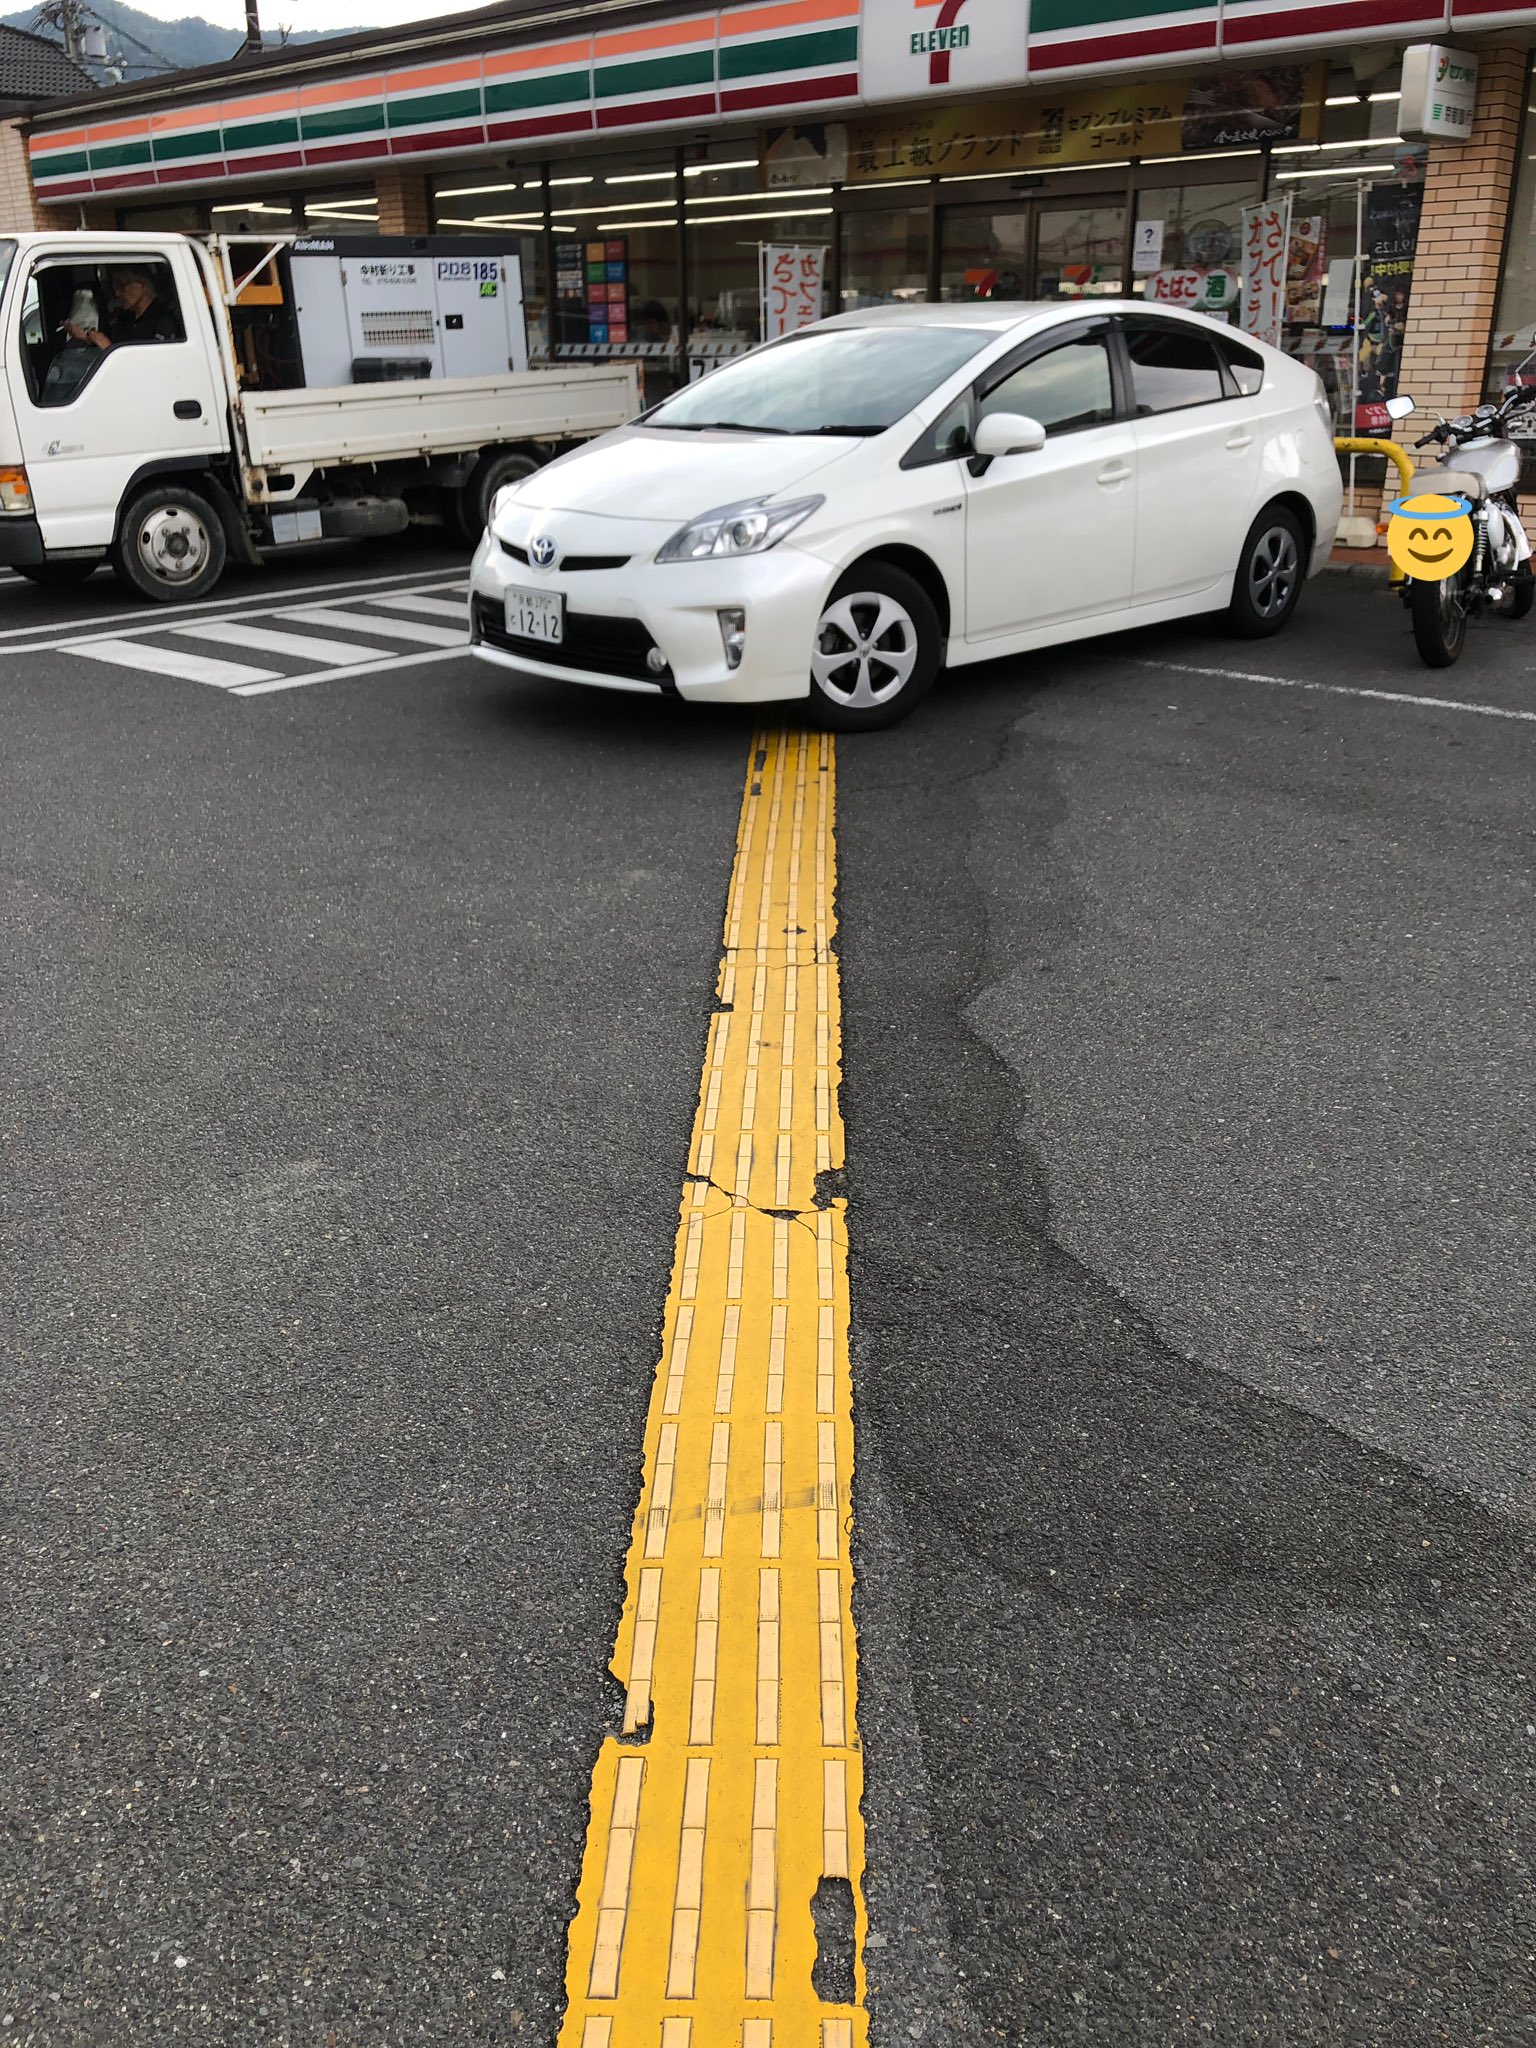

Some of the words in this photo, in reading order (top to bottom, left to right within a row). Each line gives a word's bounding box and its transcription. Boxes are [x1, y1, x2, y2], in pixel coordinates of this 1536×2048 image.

[1067, 104, 1173, 131] セブンプレミアム
[1090, 129, 1145, 149] ゴールド
[856, 129, 1025, 173] 最上級ブランド
[1154, 276, 1198, 299] たばこ
[1205, 275, 1227, 298] 酒
